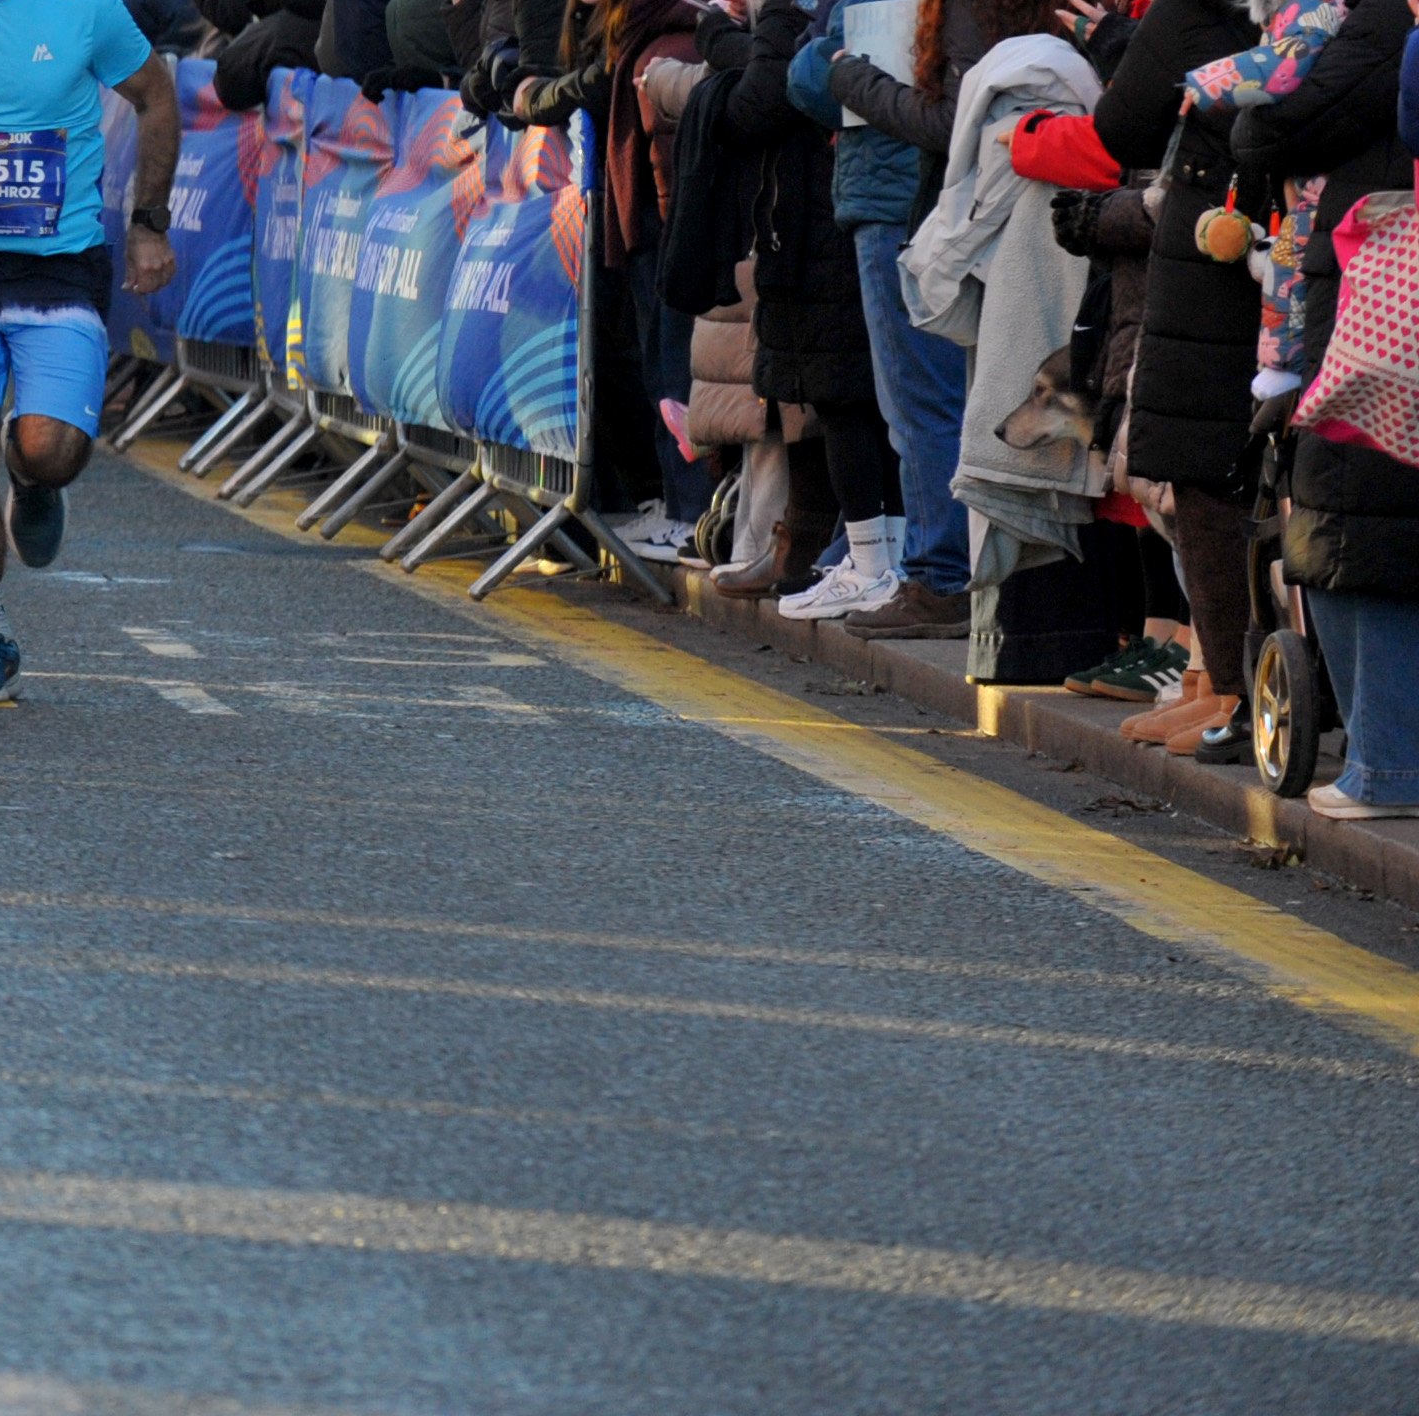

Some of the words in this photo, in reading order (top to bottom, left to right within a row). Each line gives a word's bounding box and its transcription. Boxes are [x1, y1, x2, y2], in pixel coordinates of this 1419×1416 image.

[9, 132, 33, 144] 10K
[393, 248, 422, 300] ALL
[481, 262, 515, 314] ALL
